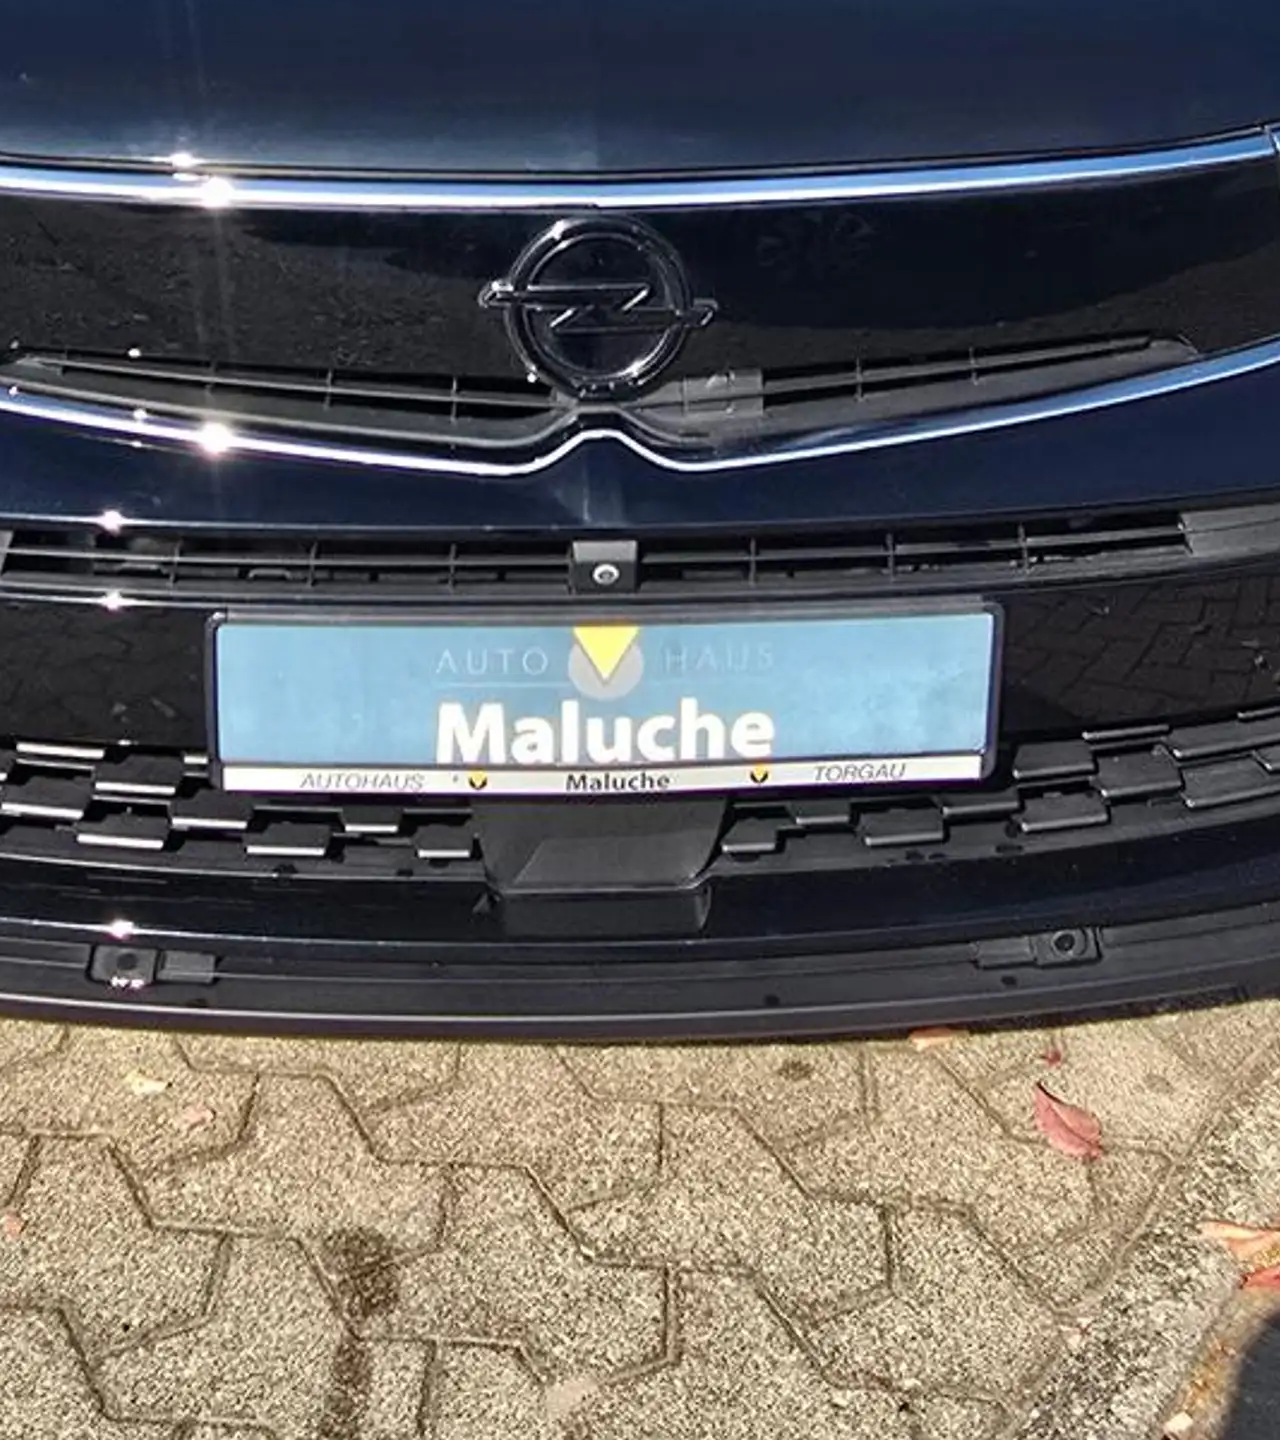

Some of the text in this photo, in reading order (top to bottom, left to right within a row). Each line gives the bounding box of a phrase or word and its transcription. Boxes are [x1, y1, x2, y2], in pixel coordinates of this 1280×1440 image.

[436, 641, 774, 676] AUTO HAUS
[435, 696, 776, 766] Maluche
[299, 763, 907, 792] AUTOHAUS Maluche TORGAU
